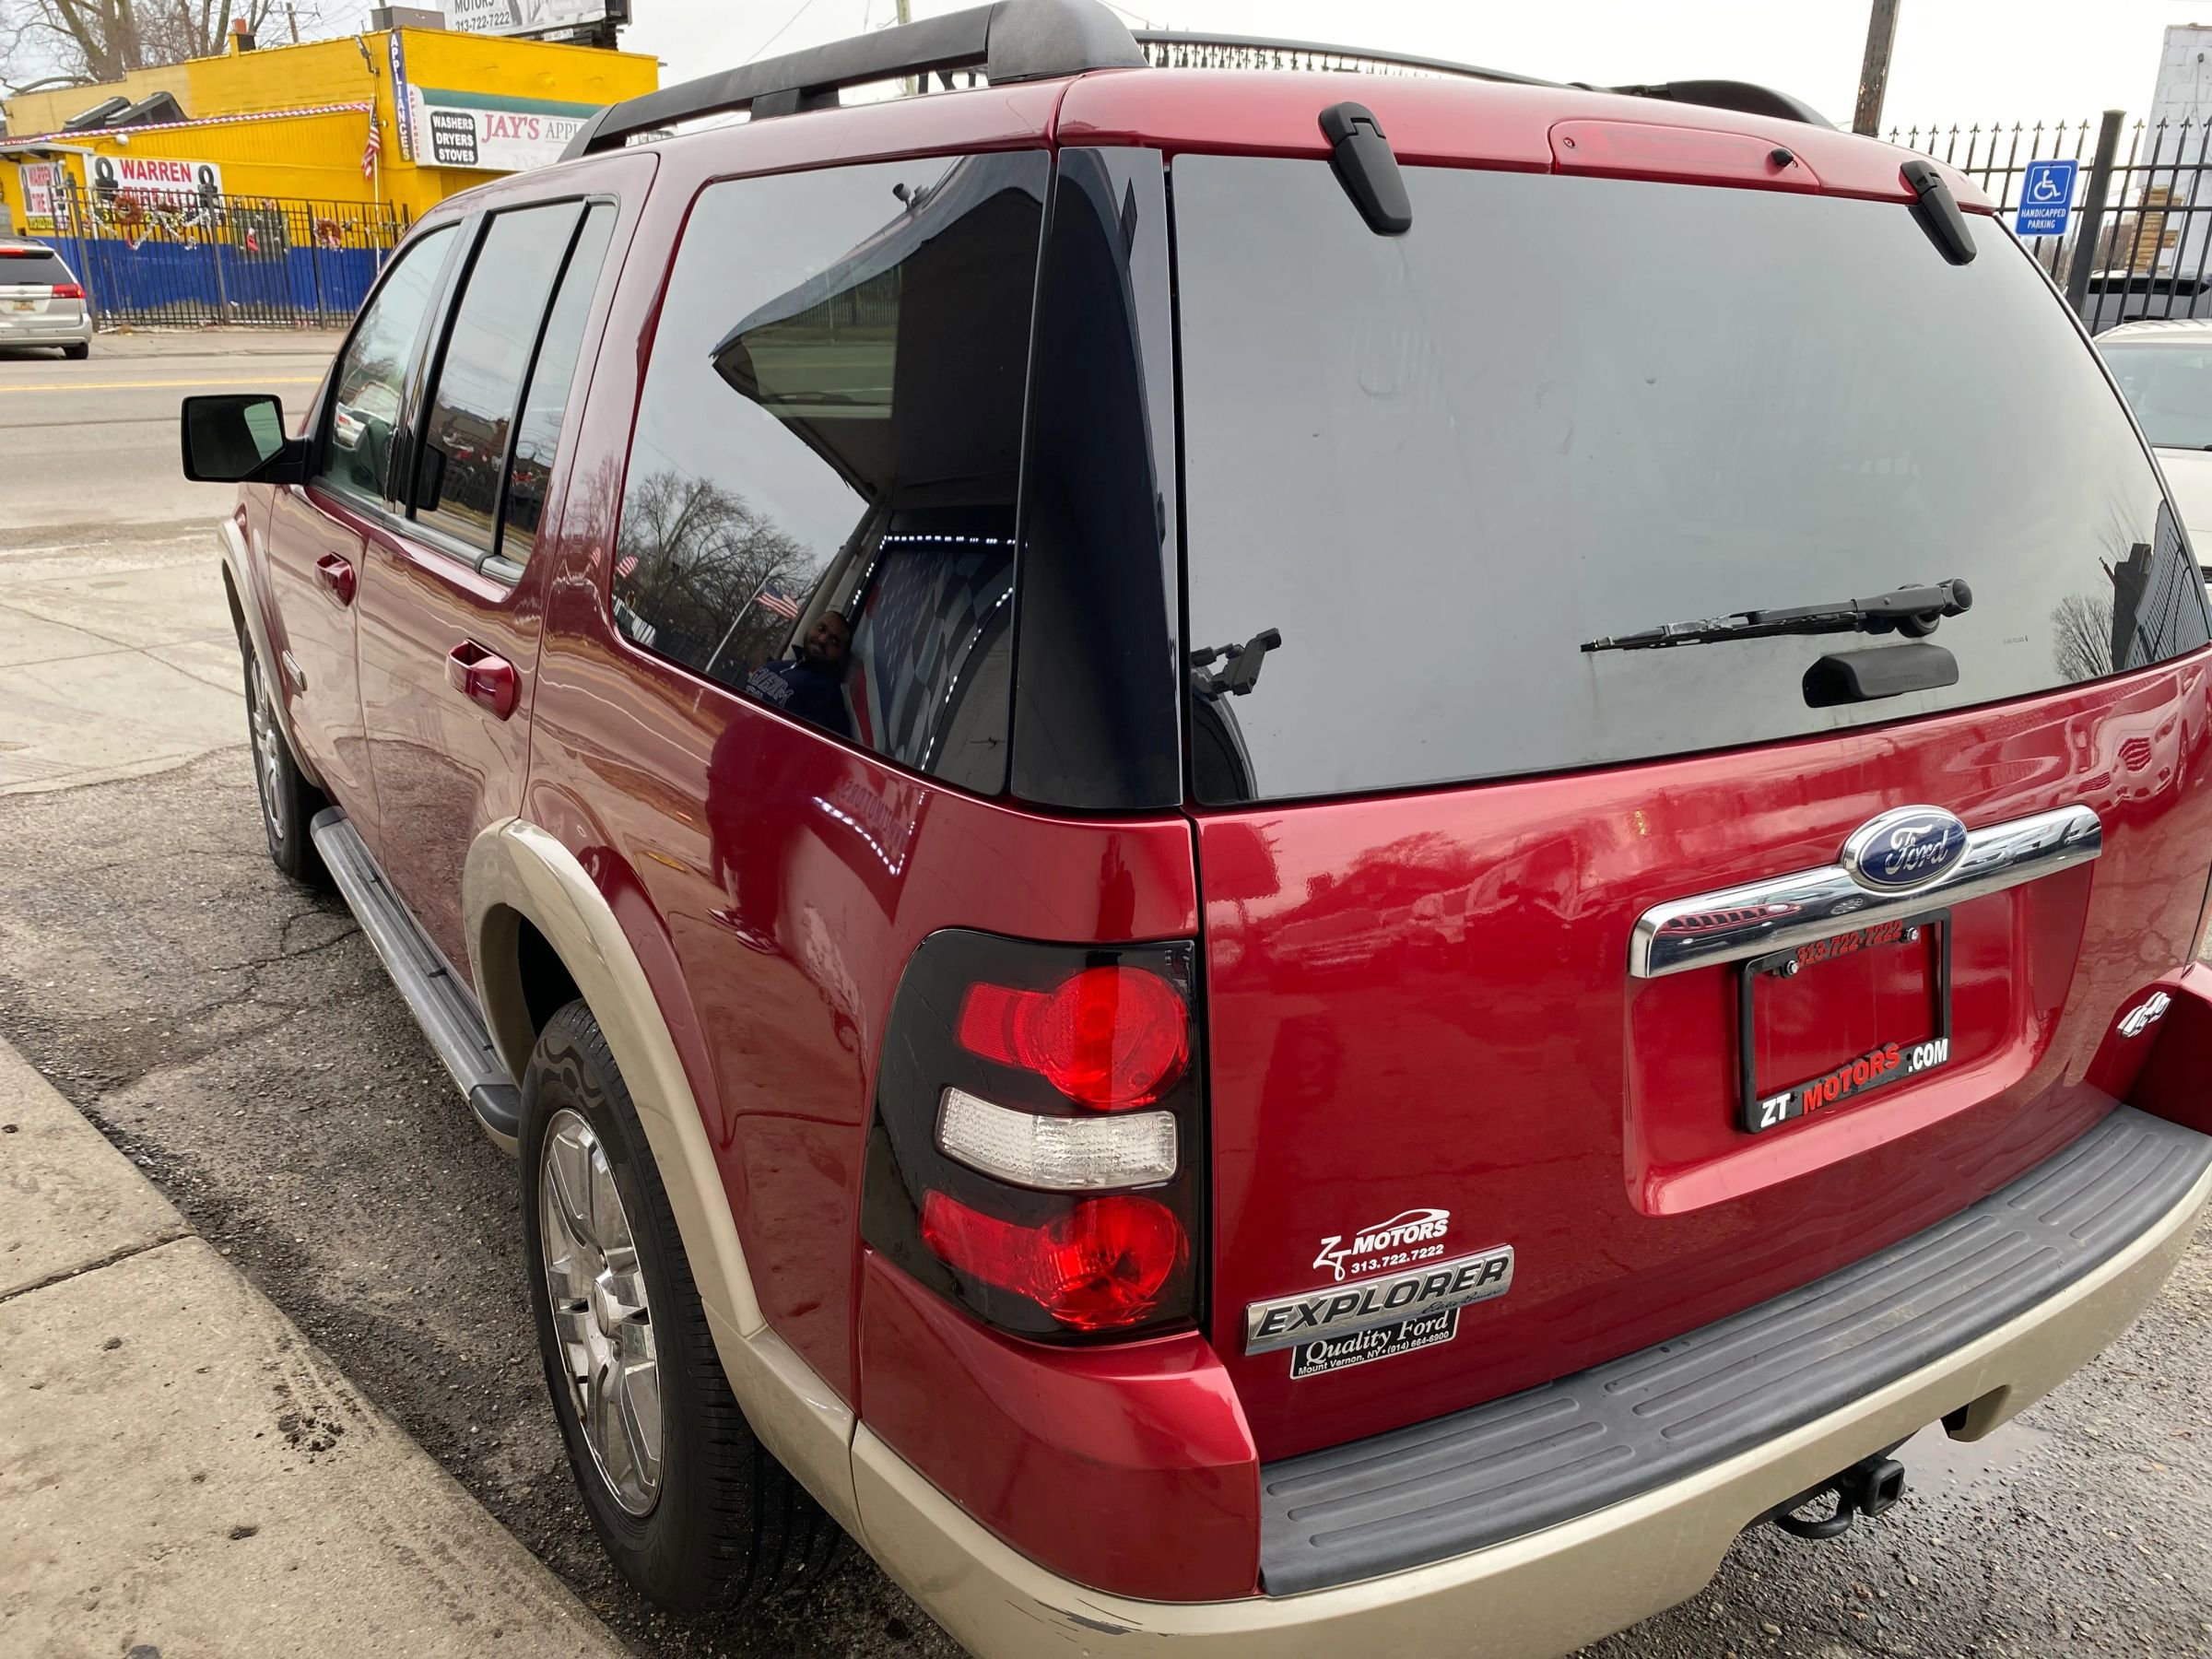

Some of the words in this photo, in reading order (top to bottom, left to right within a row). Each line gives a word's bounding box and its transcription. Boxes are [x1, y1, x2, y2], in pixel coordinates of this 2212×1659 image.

[390, 34, 410, 160] APPLIANCES
[409, 90, 420, 159] APPLIANCES
[432, 115, 474, 130] WASHERS
[436, 132, 474, 147] DRYERS
[481, 114, 540, 144] JAY'S
[119, 159, 192, 182] WARREN
[438, 148, 475, 163] STOVES
[2020, 208, 2066, 218] HANDICAPPED
[2027, 219, 2055, 229] PARKING
[1885, 824, 1948, 875] Ford
[1797, 919, 1903, 968] 313-722-7222
[1760, 1092, 1791, 1128] ZT
[1803, 1044, 1900, 1115] MOTORS
[1908, 1038, 1948, 1073] .COM
[1351, 1218, 1448, 1255] MOTORS
[1350, 1243, 1444, 1274] 313.722.7222
[1253, 1255, 1510, 1337] EXPLORER
[1298, 1362, 1327, 1375] Mount
[1367, 1347, 1382, 1359] NY
[1387, 1340, 1409, 1355] (914)
[1410, 1330, 1450, 1347] 664-6900
[1305, 1330, 1392, 1366] Quality
[1396, 1310, 1449, 1341] Ford
